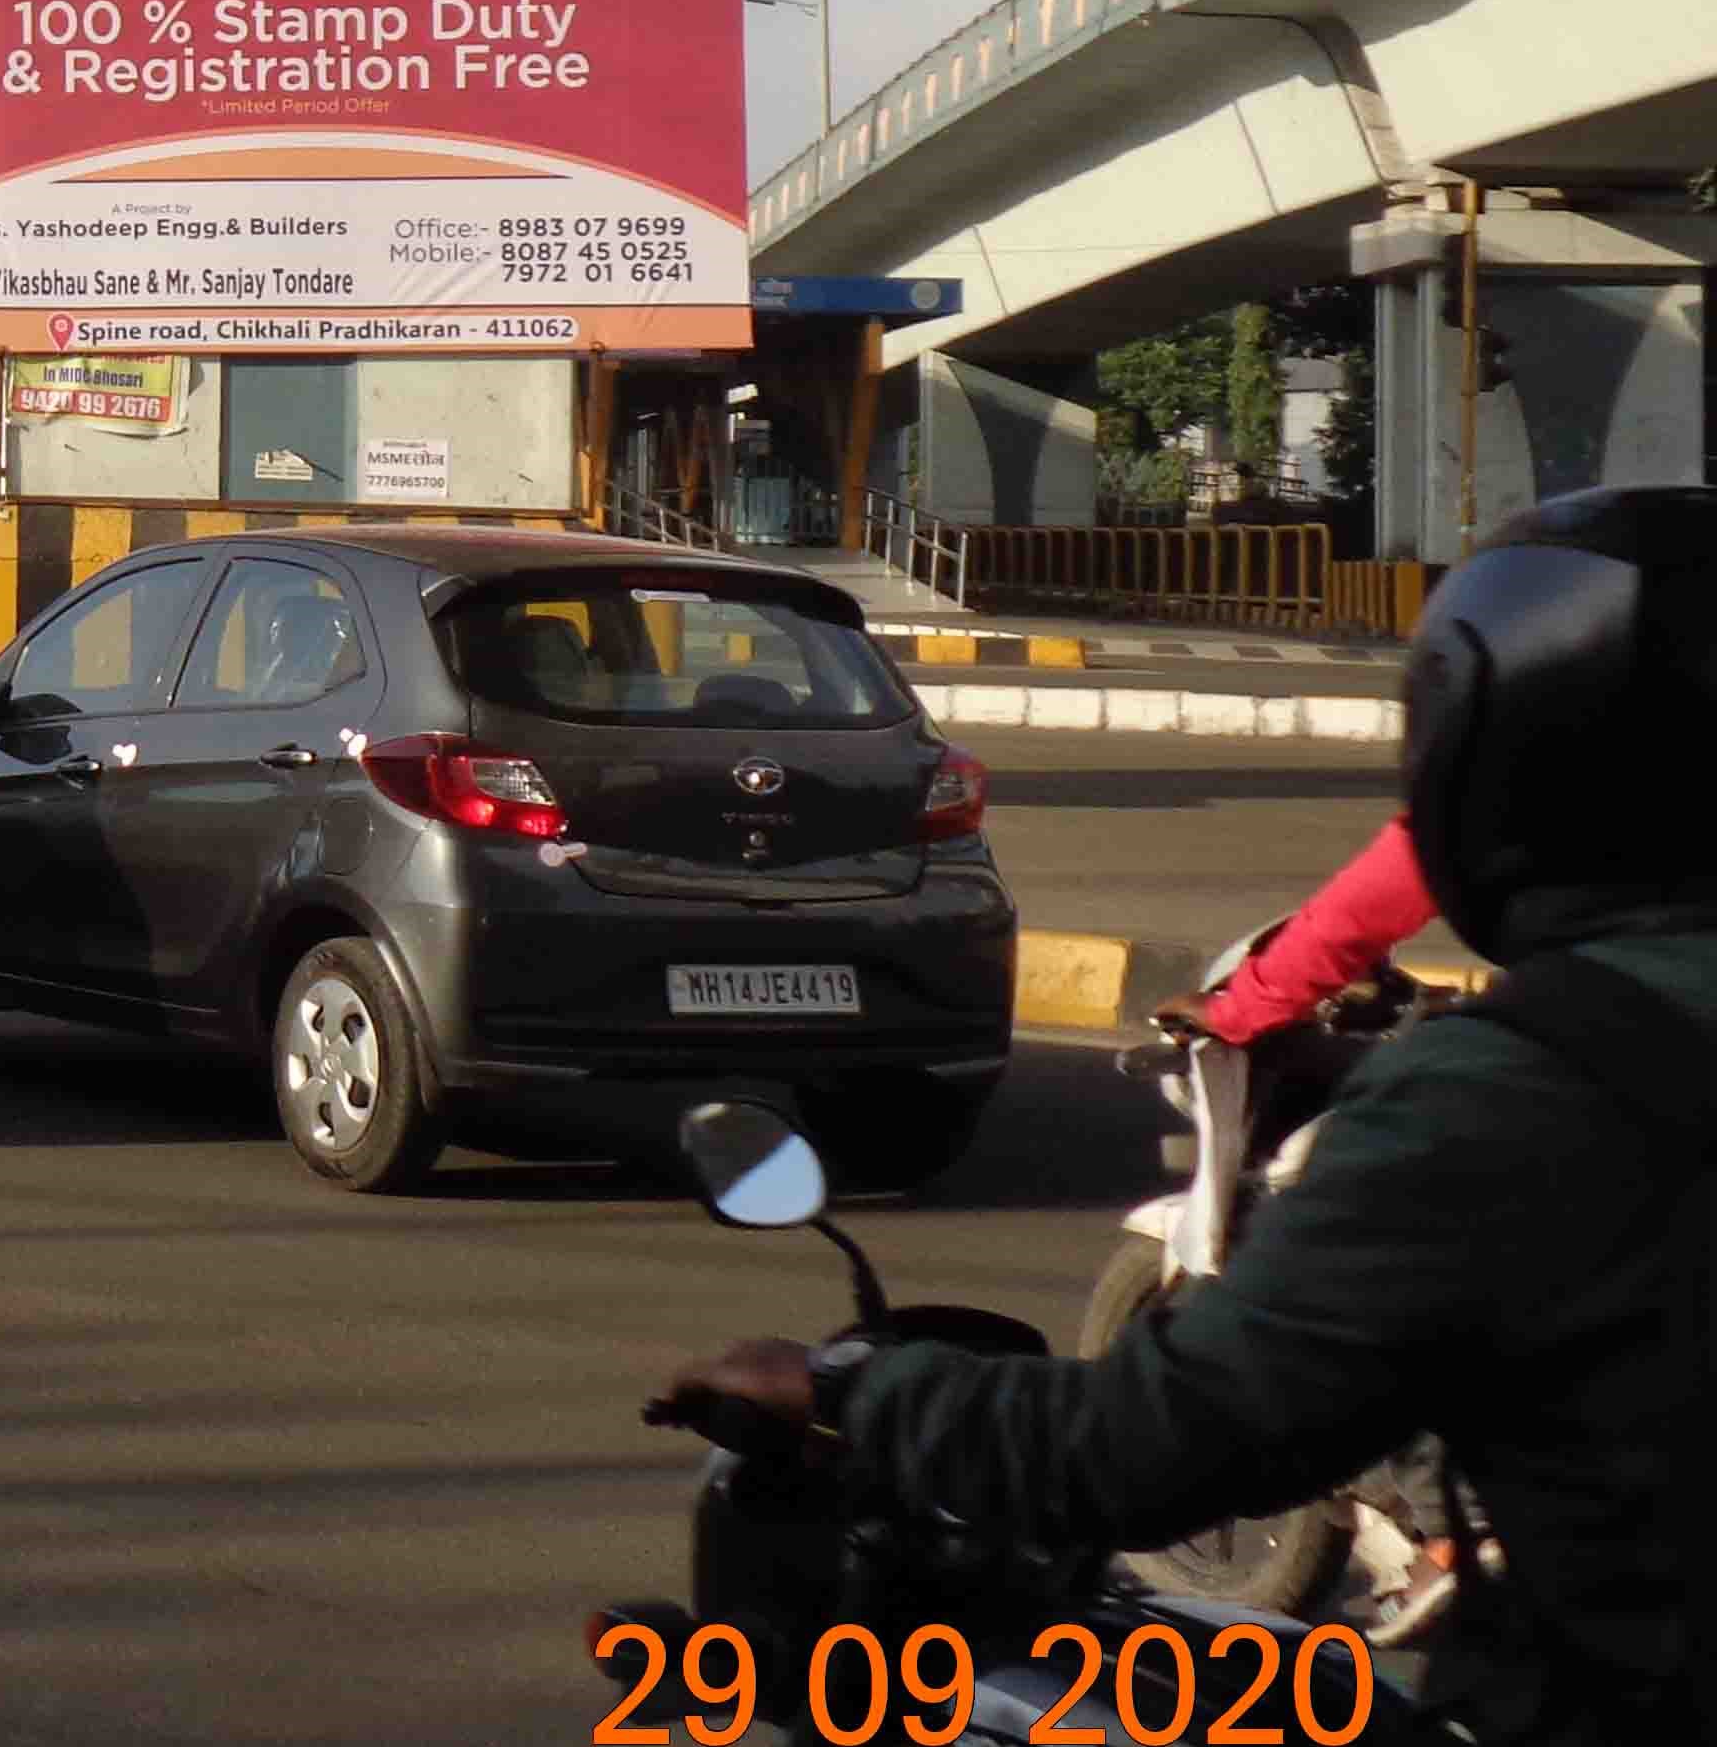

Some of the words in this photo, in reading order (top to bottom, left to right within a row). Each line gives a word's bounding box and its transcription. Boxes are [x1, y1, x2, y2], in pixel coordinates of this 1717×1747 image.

[14, 0, 122, 45] 100
[143, 0, 192, 45] %
[2, 50, 43, 94] &
[64, 46, 431, 102] Registration
[454, 44, 591, 90] Free
[281, 98, 340, 115] Period
[345, 98, 392, 114] Offer
[125, 203, 172, 217] Project
[175, 203, 193, 216] by
[16, 218, 148, 242] Yashodeep
[250, 217, 348, 236] Builders
[498, 217, 565, 237] 8983
[573, 217, 607, 237] 07
[616, 217, 686, 237] 9699
[500, 242, 568, 262] 8087
[577, 242, 612, 262] 45
[620, 241, 688, 262] 0525
[93, 269, 141, 296] Sane
[146, 269, 160, 295] &
[165, 269, 196, 296] Mr.
[201, 268, 267, 300] Sanjay
[272, 267, 354, 295] Tondare
[502, 263, 568, 283] 7972
[584, 263, 614, 283] 01
[629, 262, 694, 282] 6641
[77, 322, 143, 346] Spine
[149, 320, 209, 343] road,
[216, 320, 311, 340] Chikhali
[319, 319, 461, 340] Pradhikaran
[485, 318, 575, 339] 411062
[43, 366, 56, 383] In
[92, 369, 145, 389] Bhosari
[78, 391, 106, 415] 99
[110, 395, 161, 419] 2676
[689, 971, 854, 1005] MH14JE4419
